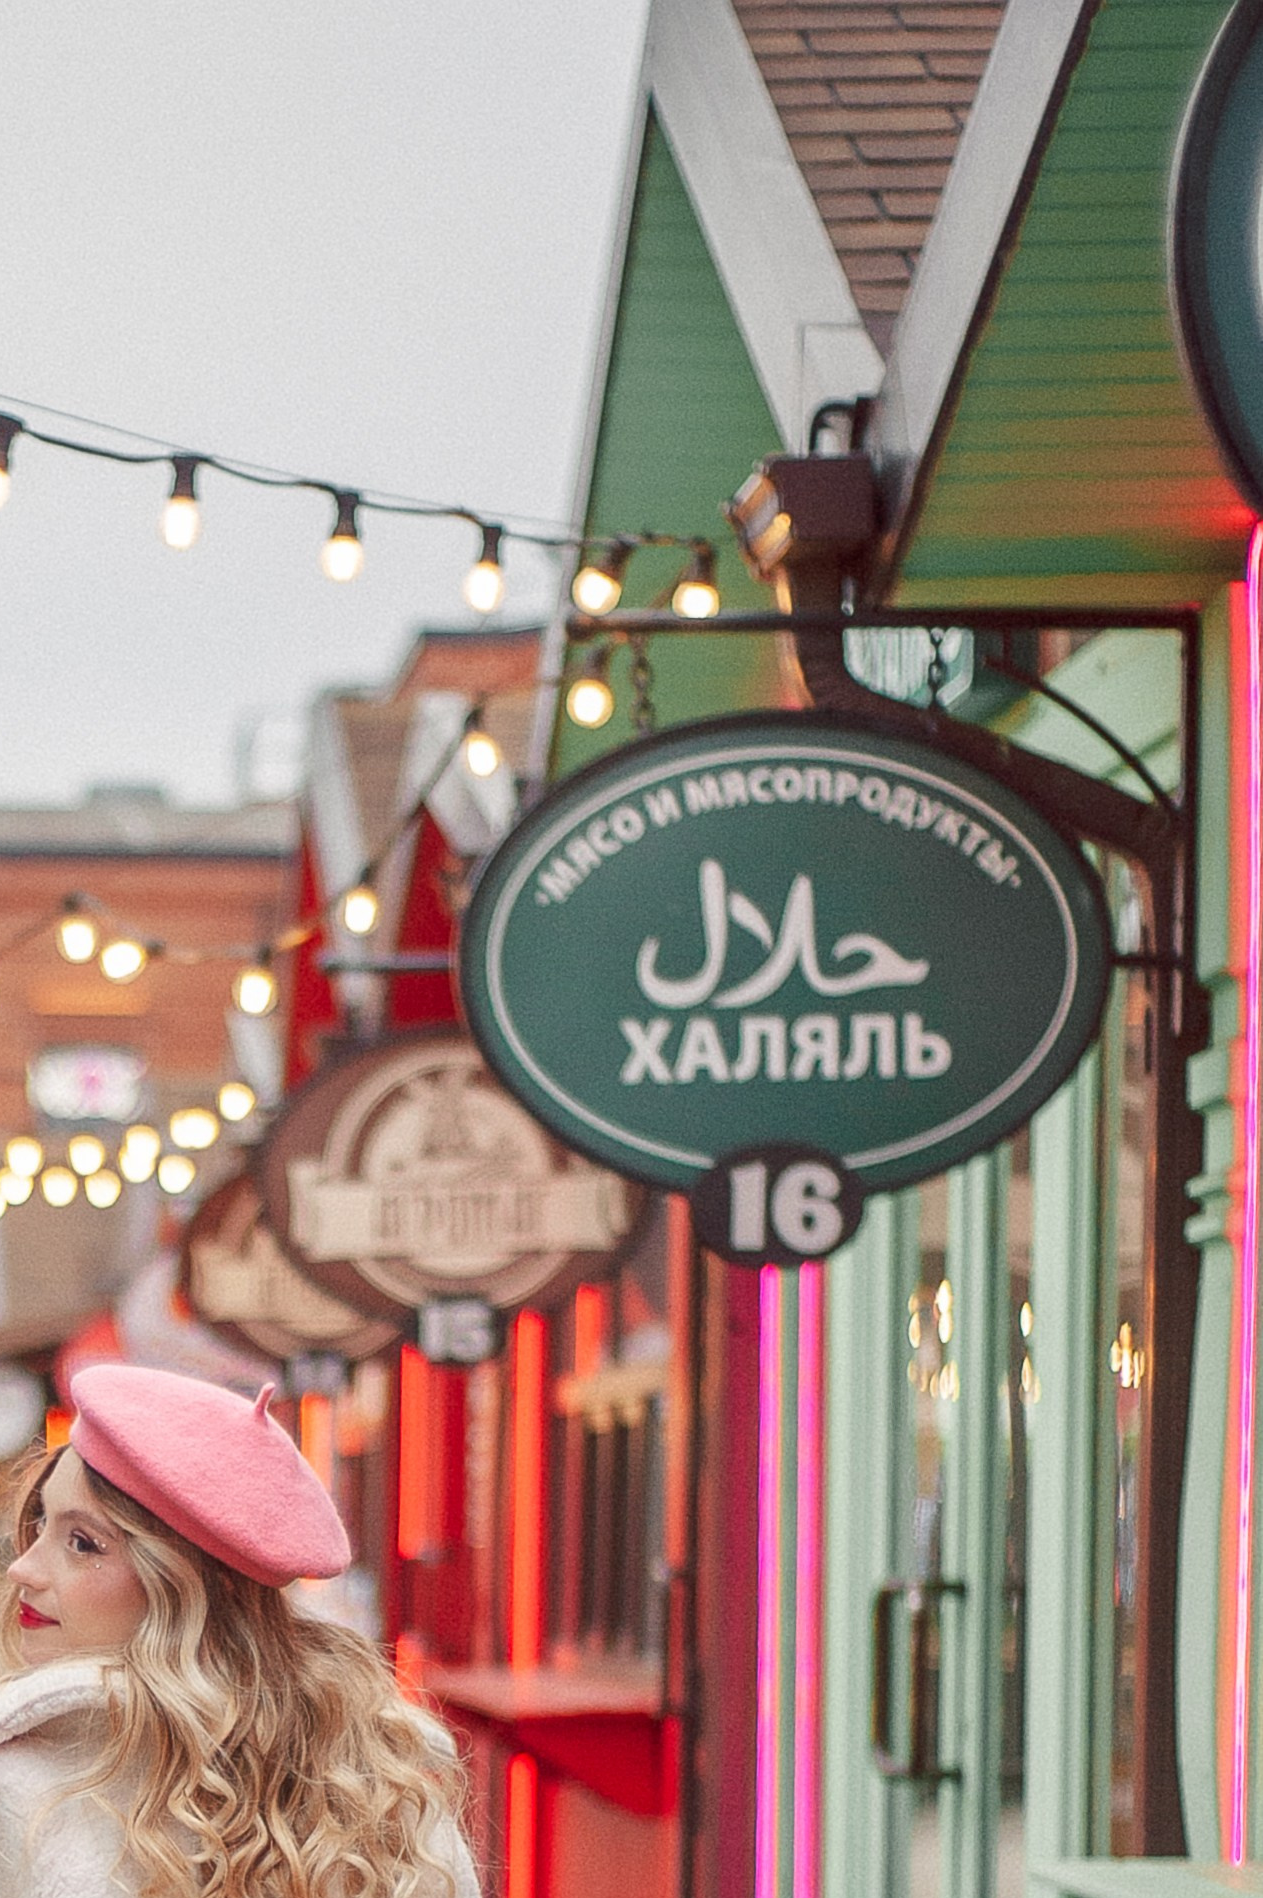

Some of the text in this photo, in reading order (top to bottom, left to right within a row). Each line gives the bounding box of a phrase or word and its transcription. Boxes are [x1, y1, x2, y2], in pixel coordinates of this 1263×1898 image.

[643, 787, 682, 827] И
[639, 859, 930, 1009] حلال
[619, 1013, 952, 1085] ХАЛЯЛЬ
[729, 1160, 842, 1254] 16
